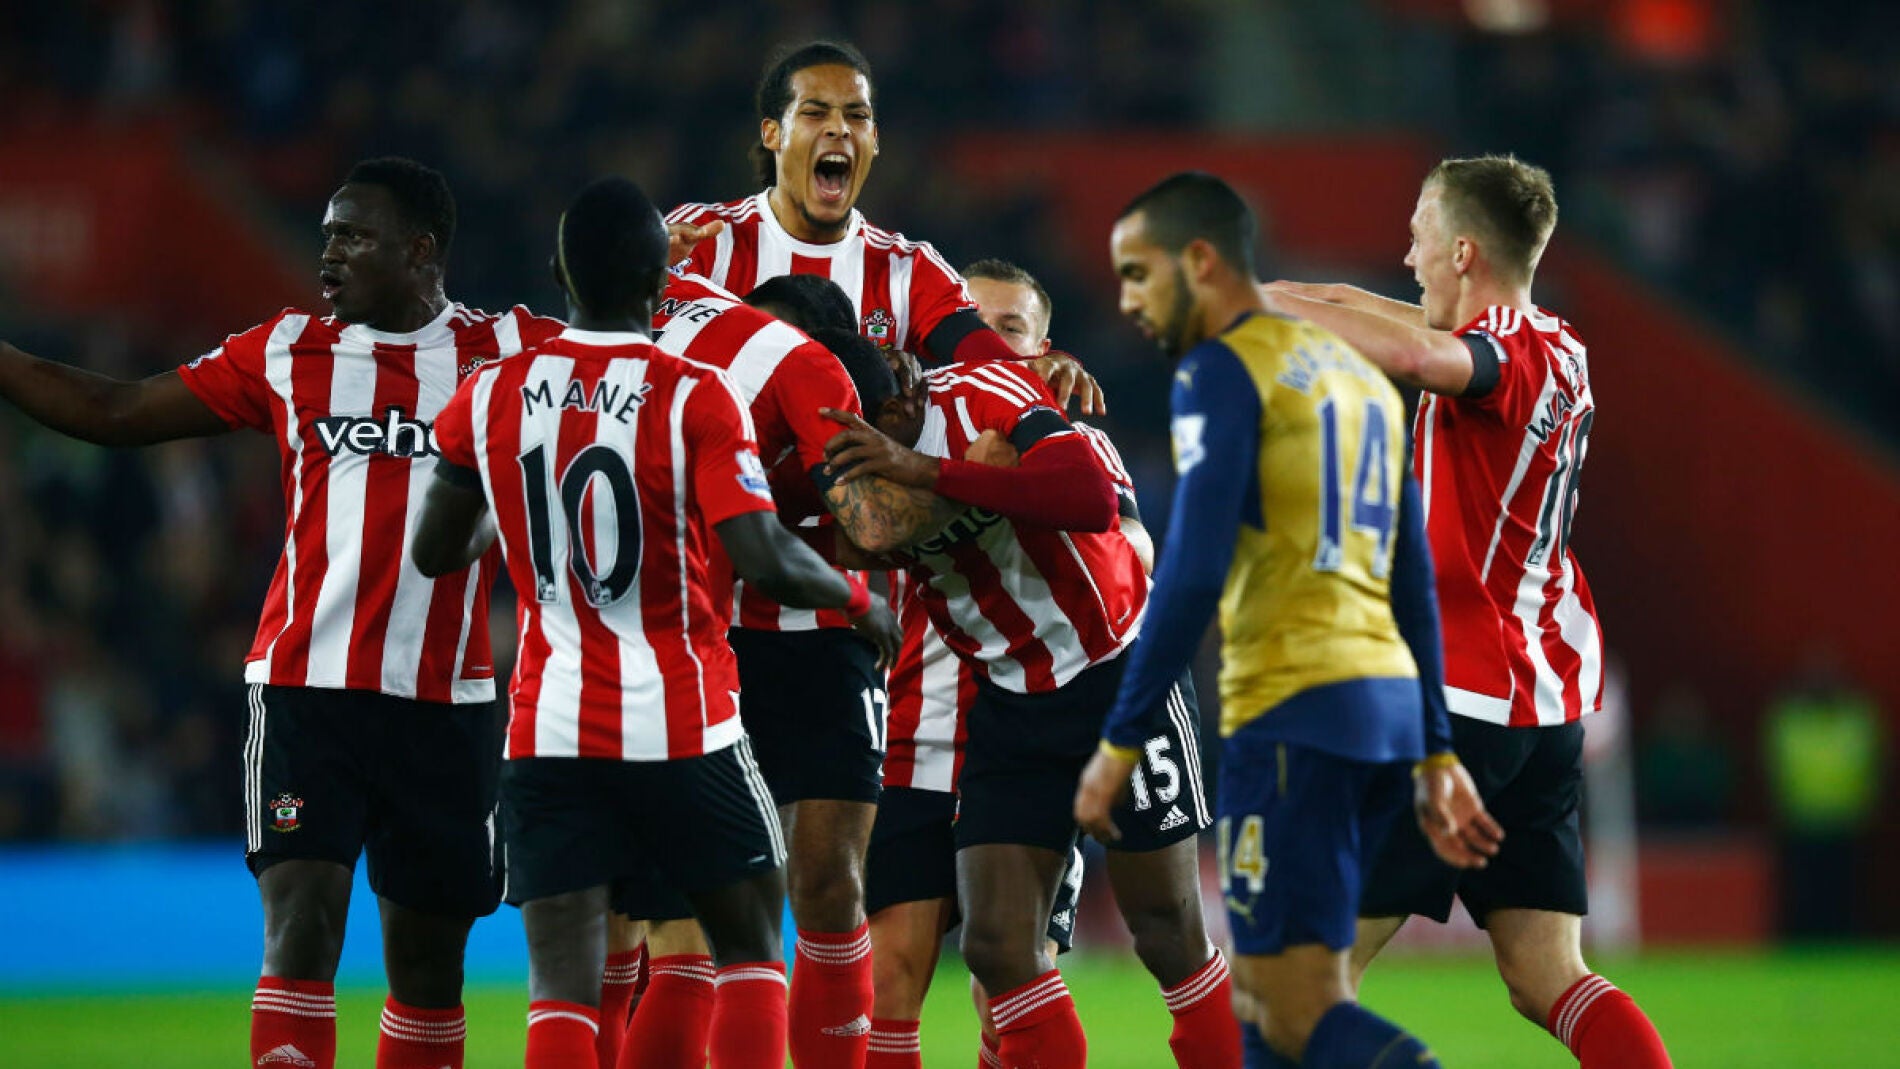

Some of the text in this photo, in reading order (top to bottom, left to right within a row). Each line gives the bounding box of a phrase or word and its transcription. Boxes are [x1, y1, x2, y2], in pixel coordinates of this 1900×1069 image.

[521, 379, 652, 424] MANÉ
[517, 442, 643, 607] 10
[1313, 394, 1393, 578] 14
[861, 687, 887, 752] 17
[1130, 735, 1180, 811] 15
[1217, 814, 1268, 893] 14
